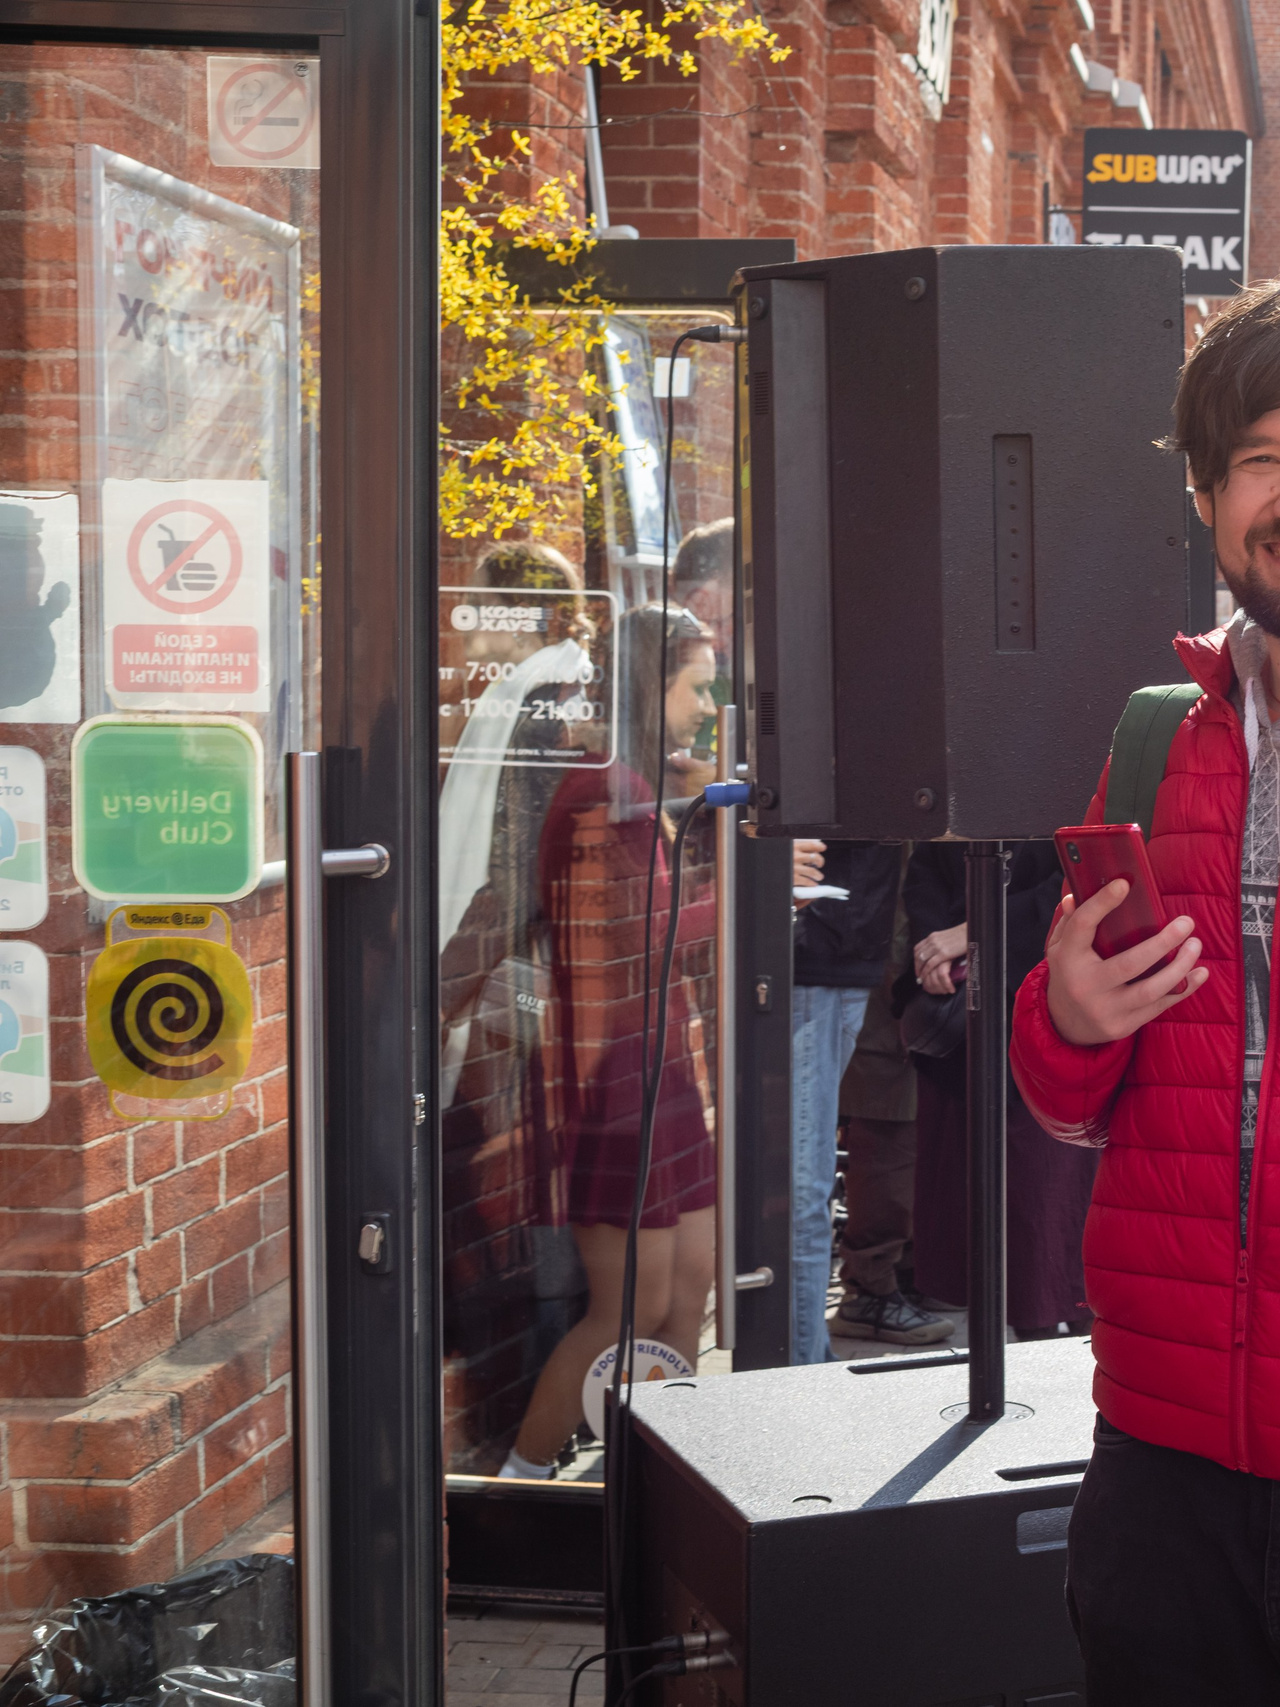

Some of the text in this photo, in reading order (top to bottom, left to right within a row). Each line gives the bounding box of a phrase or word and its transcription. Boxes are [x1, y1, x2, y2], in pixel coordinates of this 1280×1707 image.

[1086, 154, 1244, 184] SUBWAY
[480, 606, 543, 620] КОФЕ
[480, 619, 539, 633] ХАУЗ
[130, 913, 205, 925] Яндекс Еда
[599, 1349, 619, 1370] DO
